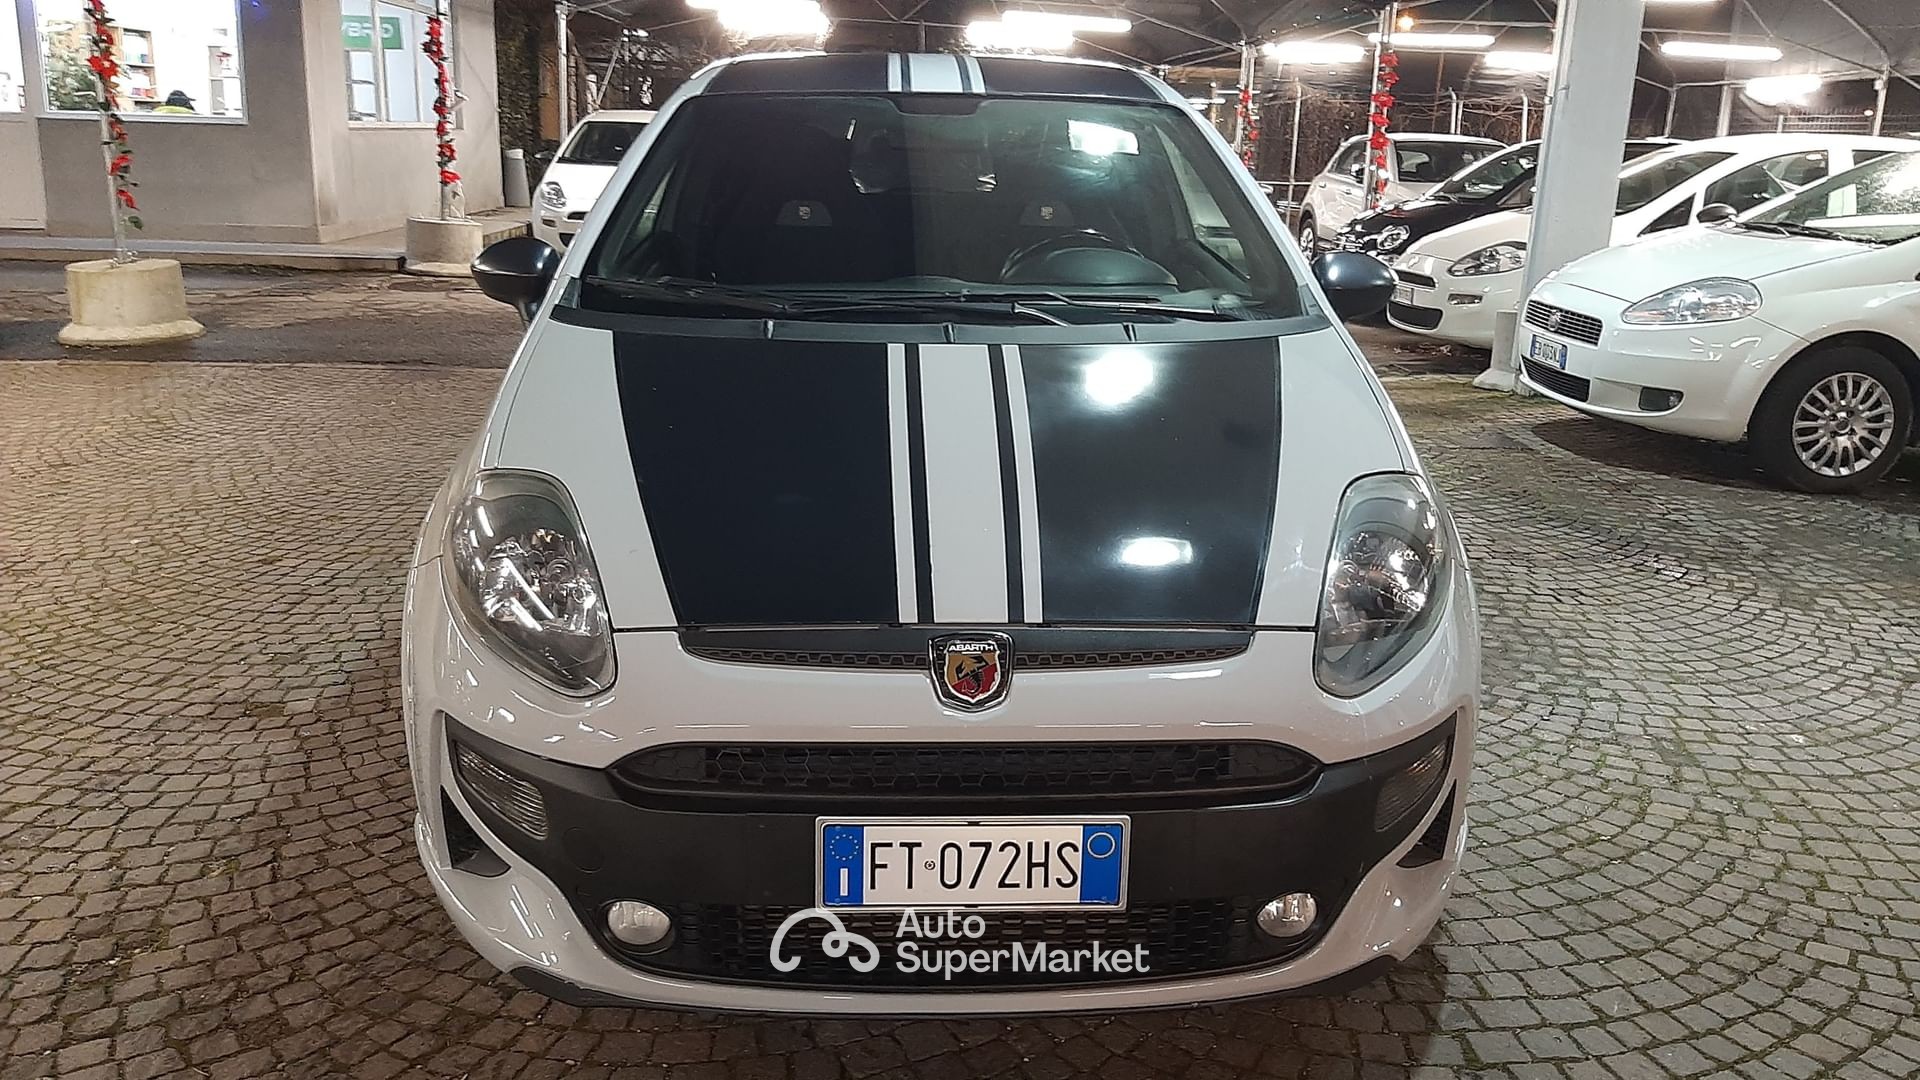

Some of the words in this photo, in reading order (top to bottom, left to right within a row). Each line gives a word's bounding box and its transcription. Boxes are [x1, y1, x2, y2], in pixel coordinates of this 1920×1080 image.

[948, 643, 994, 652] ABARTH
[869, 841, 923, 890] FT
[938, 841, 1080, 890] 072HS
